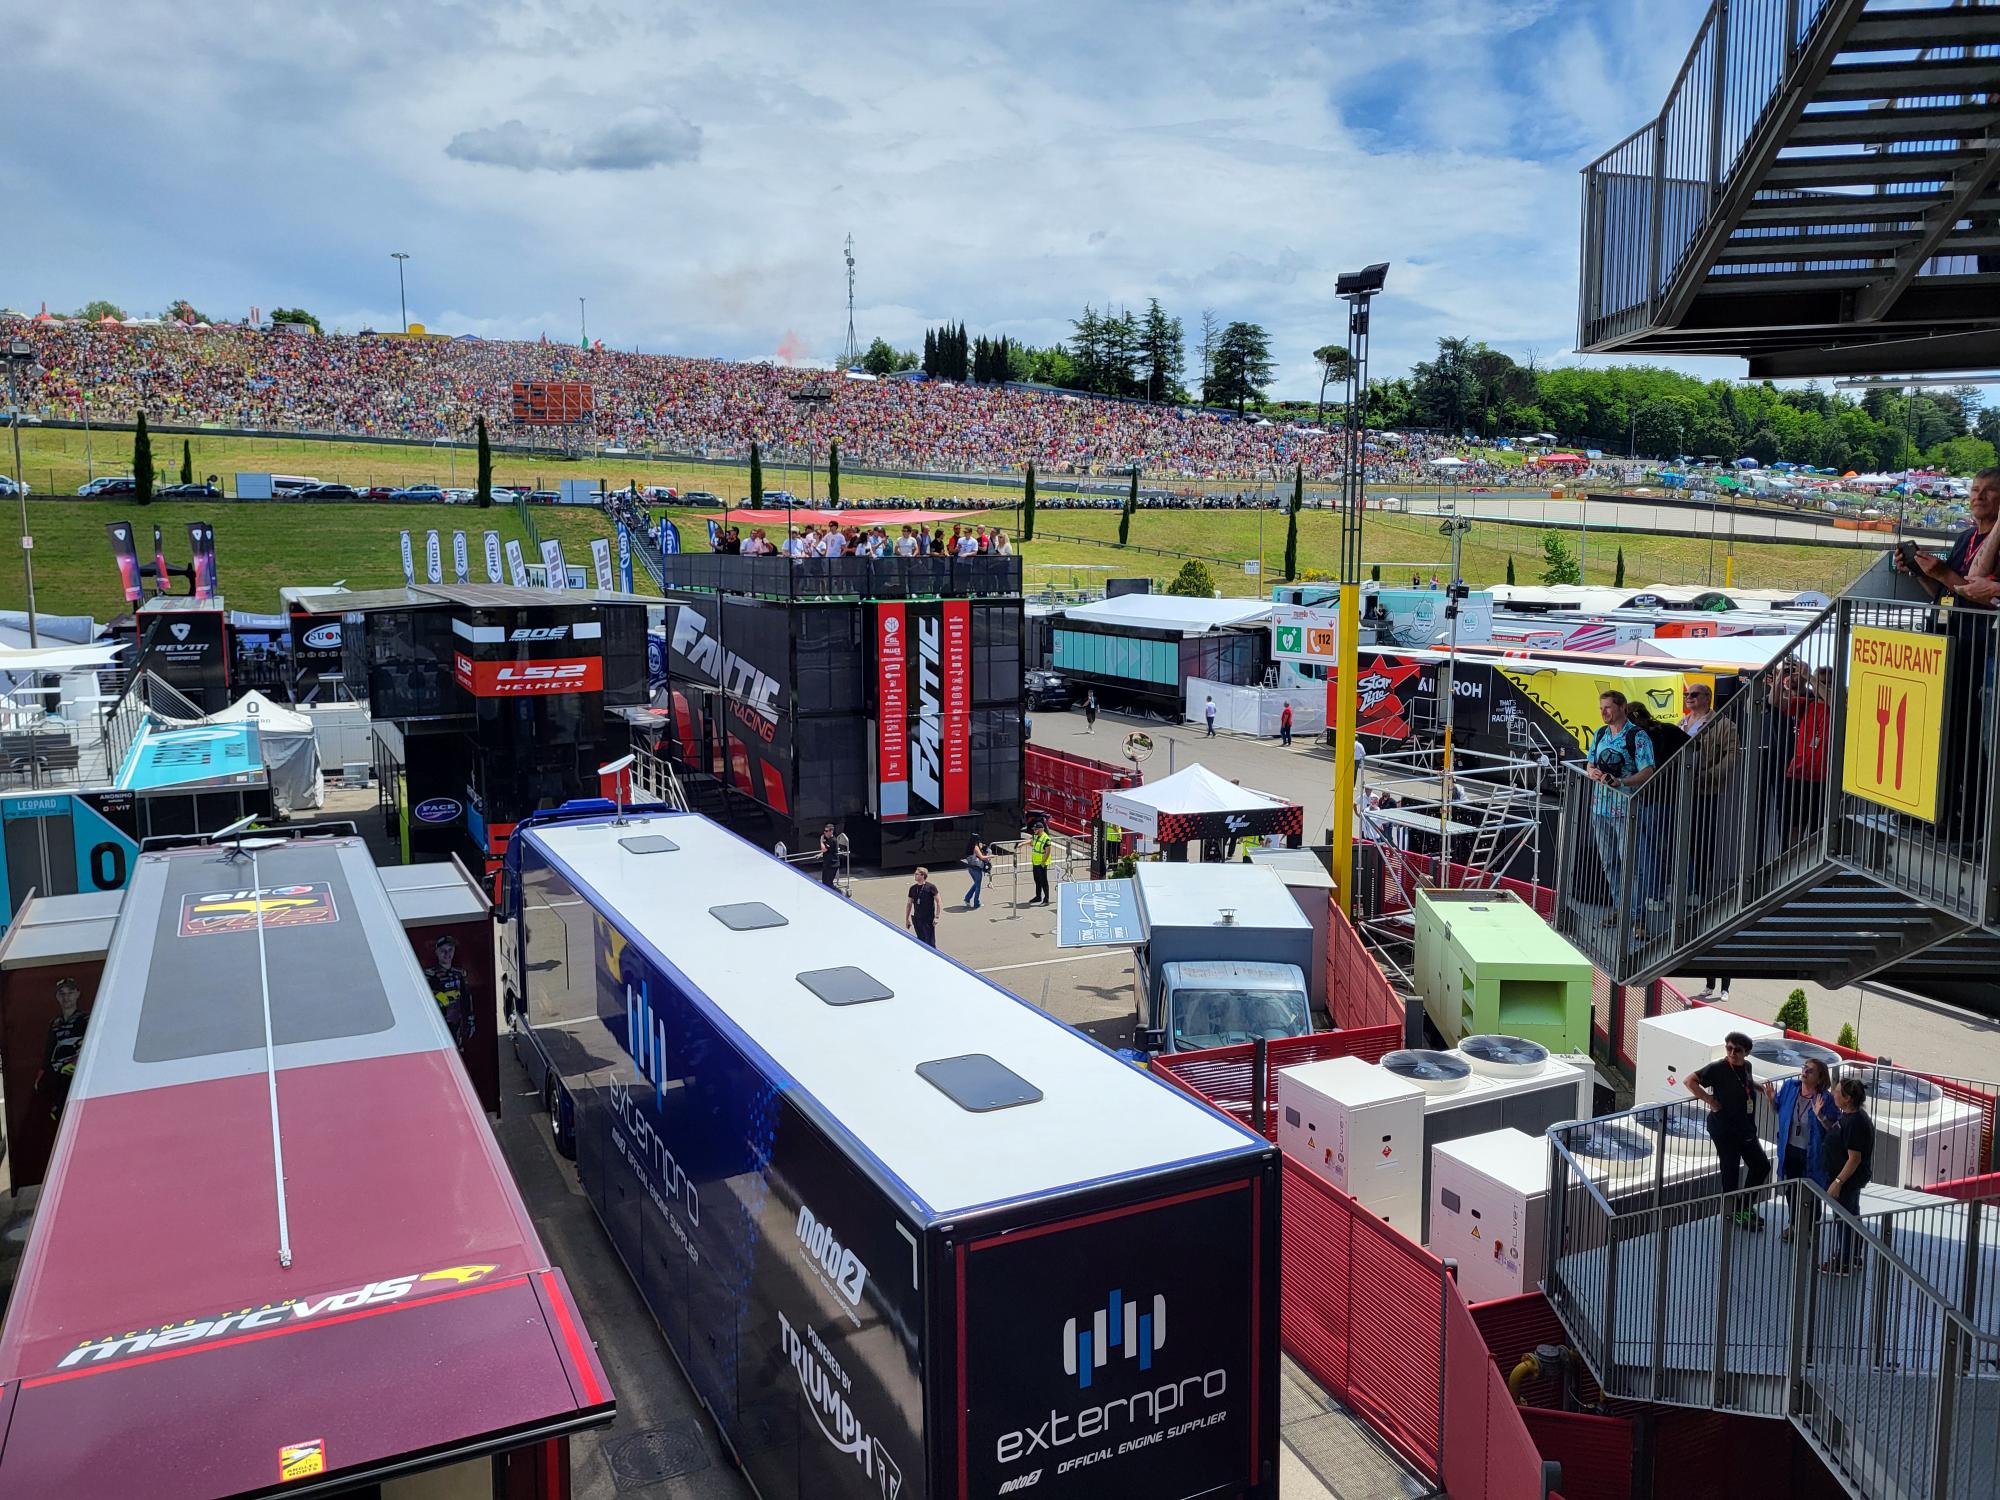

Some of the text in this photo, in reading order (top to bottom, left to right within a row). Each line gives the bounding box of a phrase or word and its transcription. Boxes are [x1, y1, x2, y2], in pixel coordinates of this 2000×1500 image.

[310, 632, 342, 641] SUO
[1317, 634, 1331, 645] 112
[1853, 638, 1942, 675] RESTAURANT
[457, 655, 472, 676] LS2
[495, 681, 585, 691] HELMETS
[496, 664, 587, 680] LS2
[672, 605, 780, 725] FANTIC
[1357, 672, 1392, 692] Star
[730, 699, 777, 743] RACING
[912, 616, 940, 809] FANTIC
[1505, 706, 1516, 715] WE
[17, 799, 57, 810] LEOPARD
[610, 1072, 700, 1227] externpro
[627, 1150, 650, 1191] OFFICIAL
[649, 1180, 670, 1219] ENGINE
[669, 1213, 699, 1267] SUPPLIER
[1512, 1203, 1520, 1248] CLIVET
[796, 1205, 868, 1306] moto2
[78, 1298, 296, 1349] RACING TEAM
[807, 1323, 852, 1394] POWERED BY
[778, 1310, 873, 1479] TRIUMPH
[996, 1368, 1227, 1463] externpro
[998, 1410, 1227, 1496] moto2 OFFICIAL ENGINE SUPPLIER
